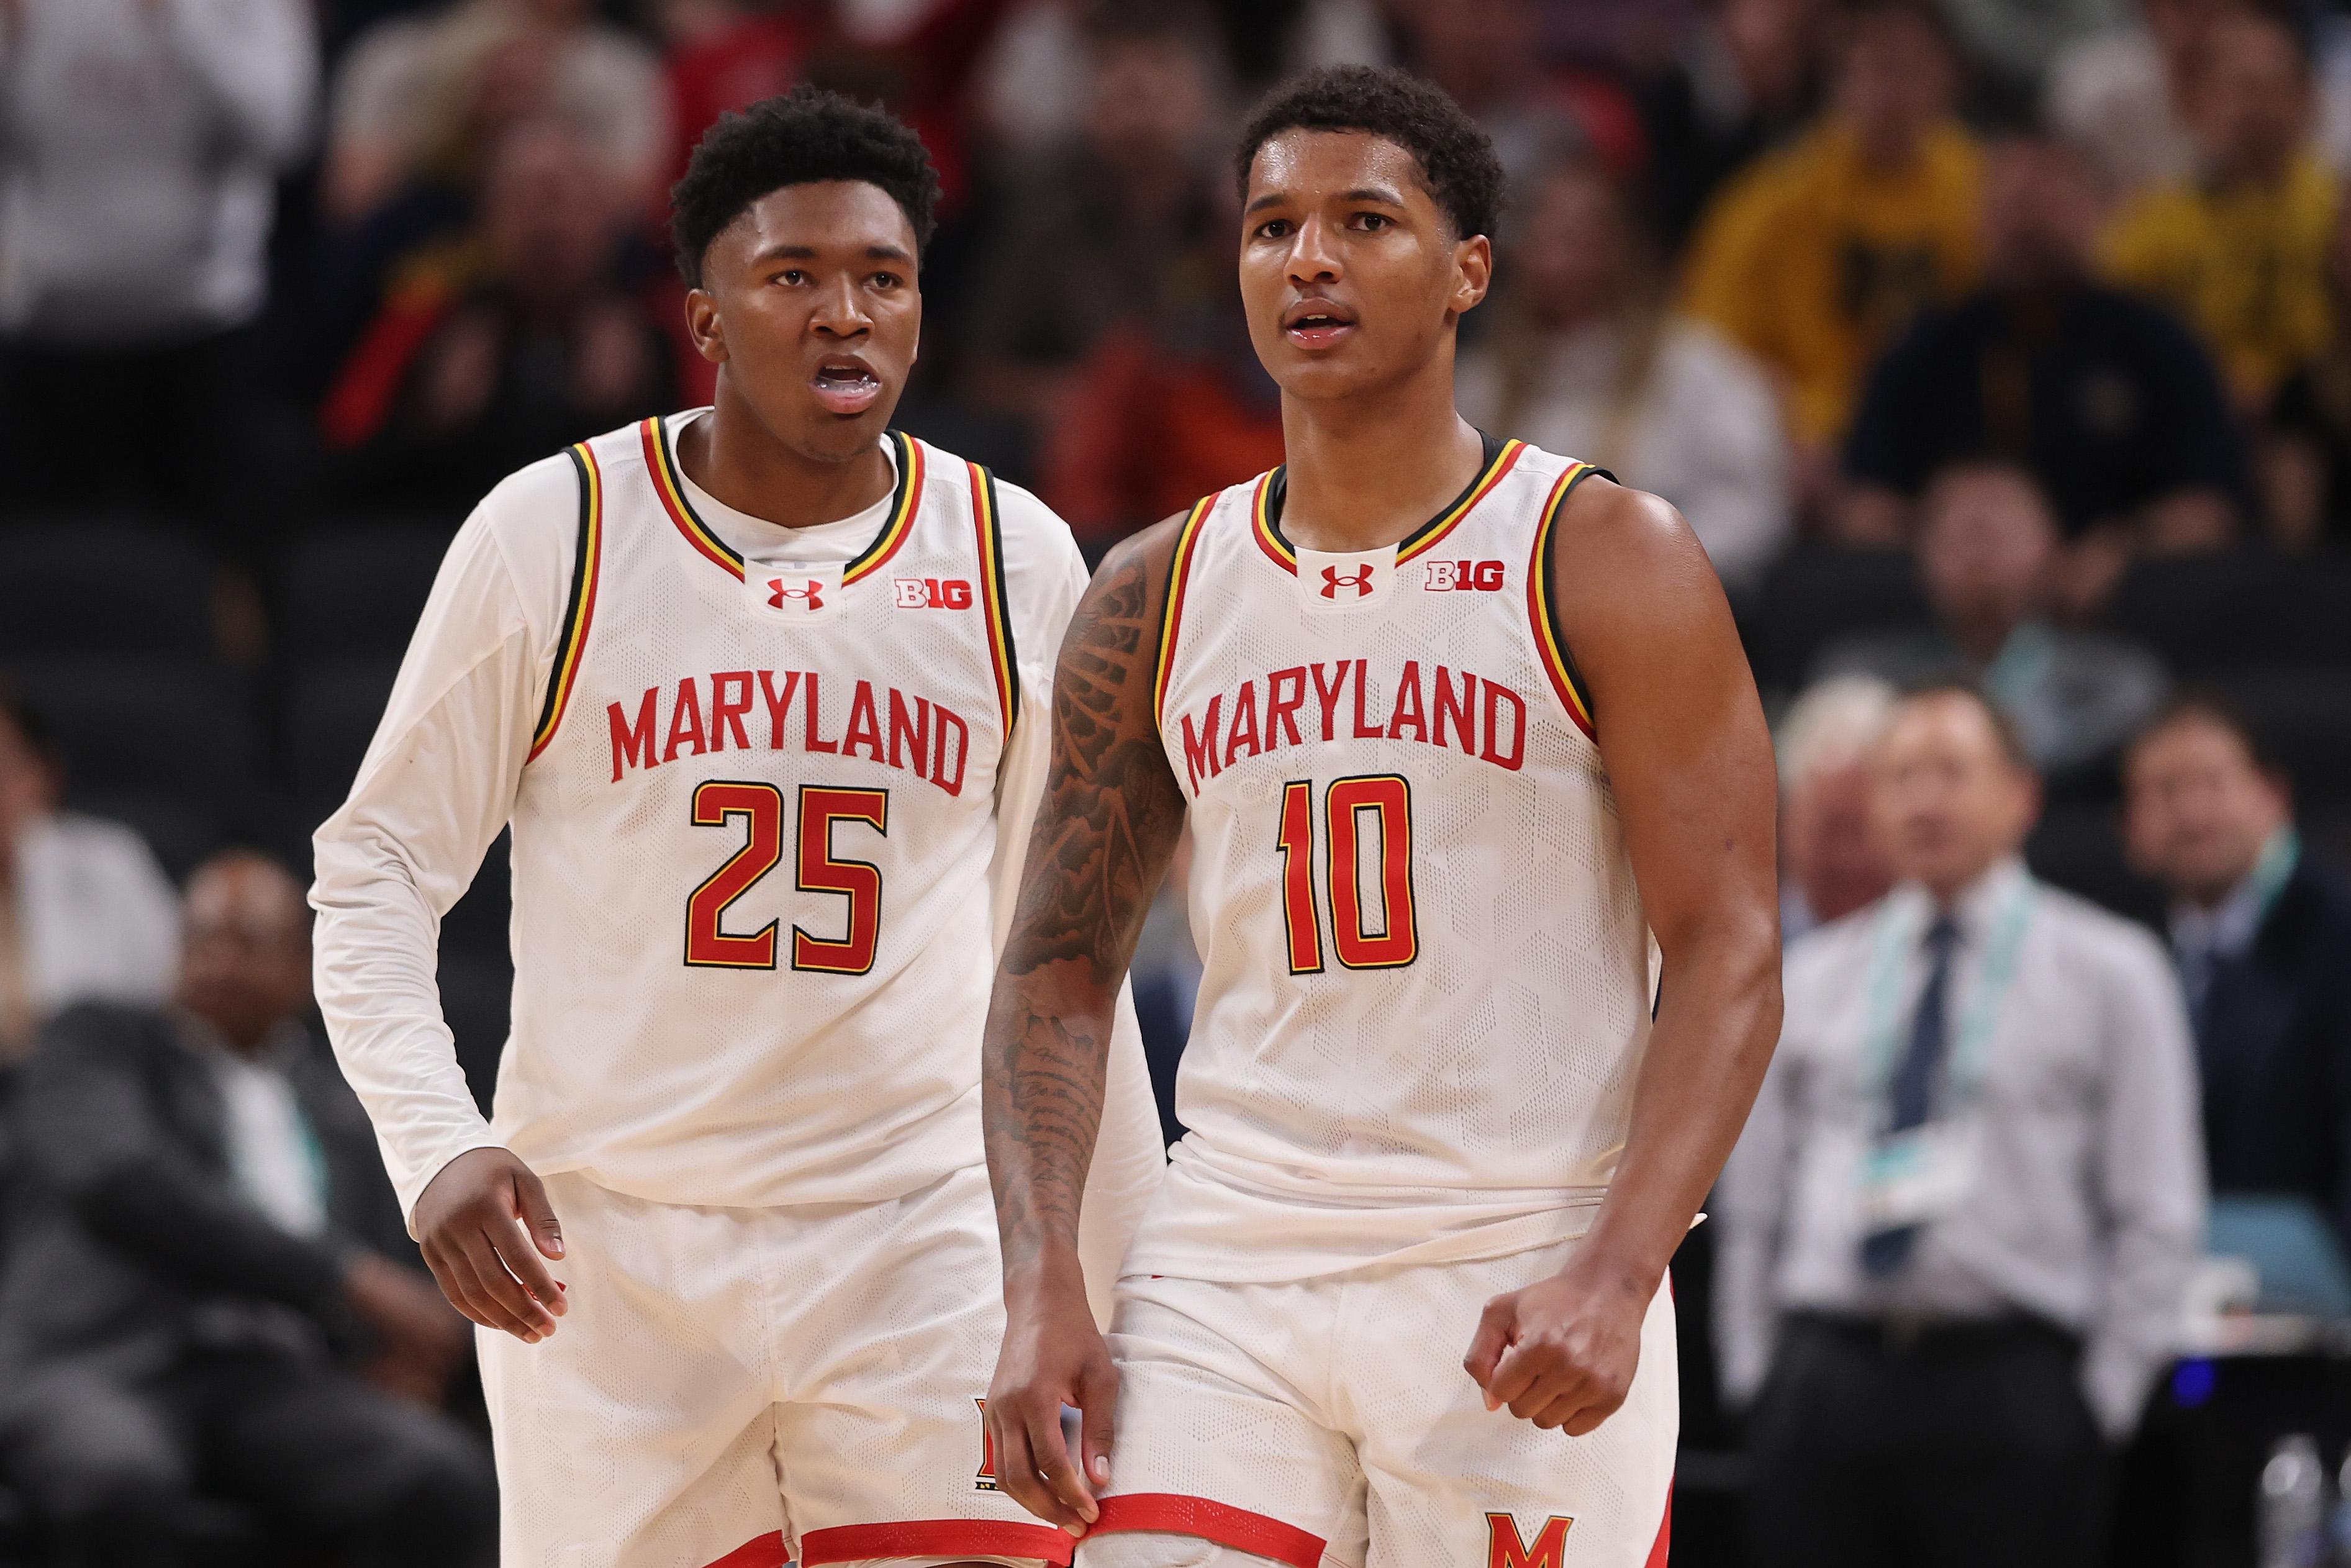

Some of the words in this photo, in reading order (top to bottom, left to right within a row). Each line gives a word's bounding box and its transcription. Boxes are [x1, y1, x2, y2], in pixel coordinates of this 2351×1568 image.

[607, 670, 969, 797] MARYLAND
[1181, 659, 1526, 797] MARYLAND
[684, 780, 889, 976] 25
[1276, 774, 1418, 976] 10
[1485, 1512, 1574, 1568] M
